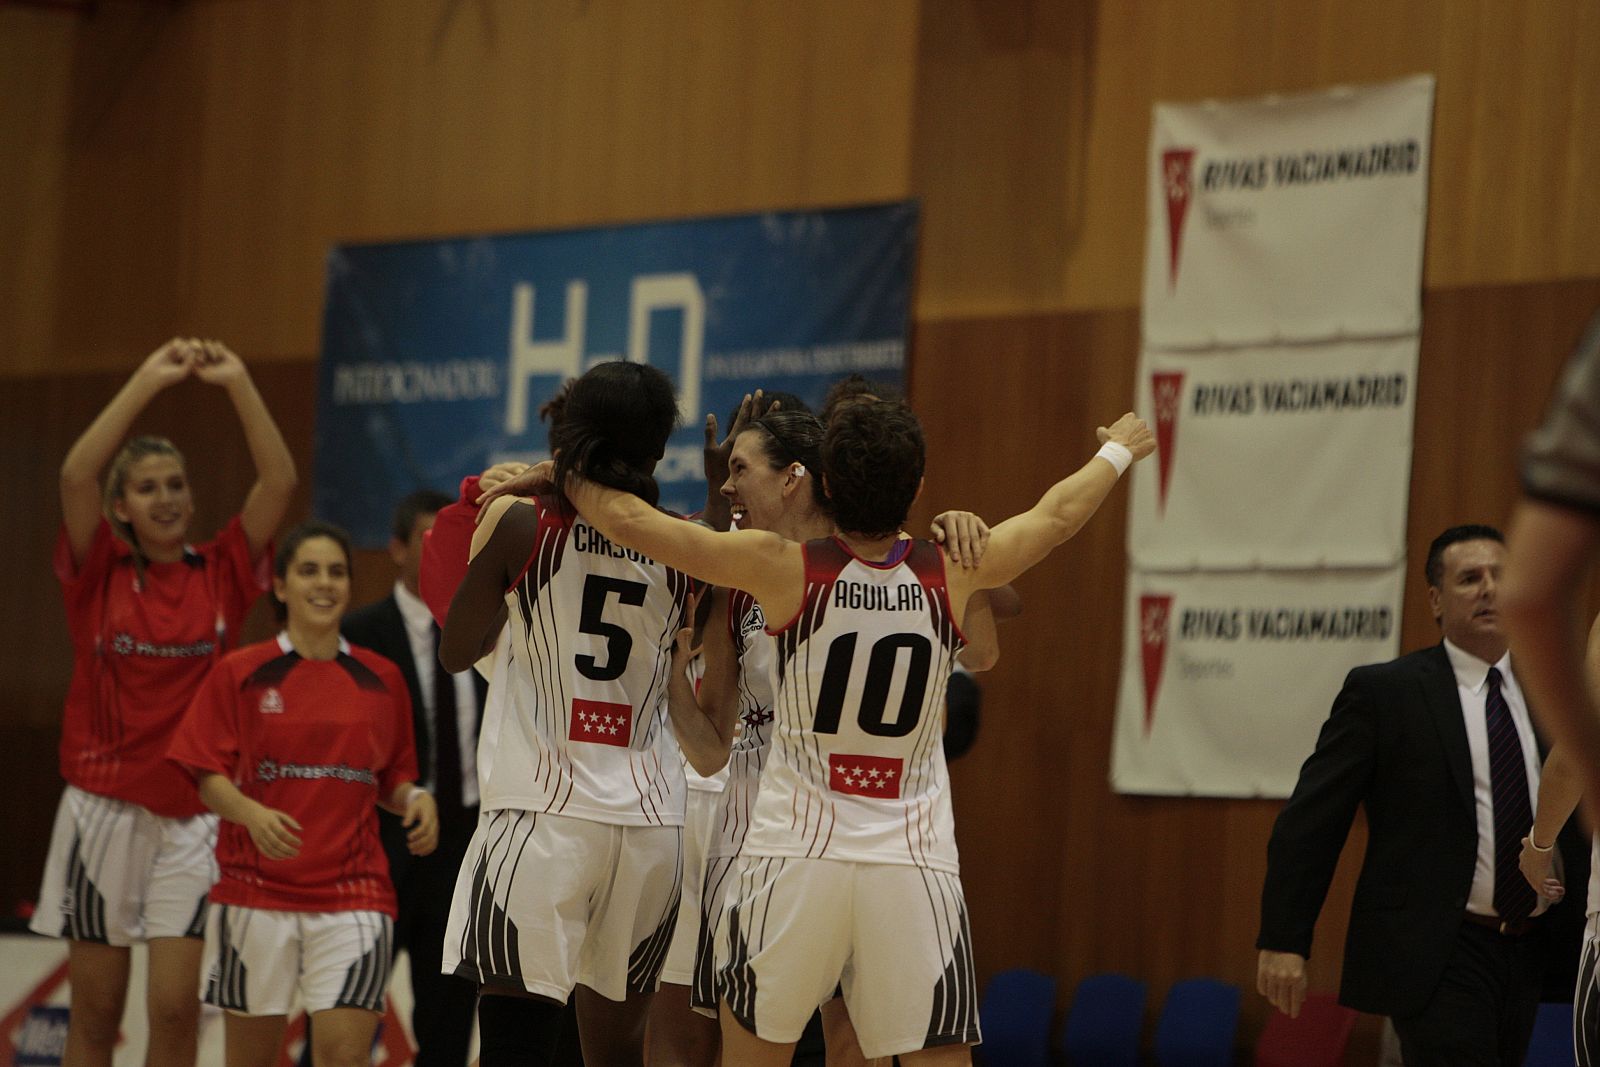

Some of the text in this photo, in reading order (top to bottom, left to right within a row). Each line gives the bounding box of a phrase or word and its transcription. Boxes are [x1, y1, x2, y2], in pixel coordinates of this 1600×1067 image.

[1204, 141, 1420, 191] RIVAS VACIAMADRID
[1193, 373, 1407, 415] RIVAS VACIAMADRID
[835, 580, 924, 612] AGUILAR
[575, 573, 648, 681] 5
[1181, 606, 1393, 641] RIVAS VACIAMADRID
[812, 631, 932, 738] 10
